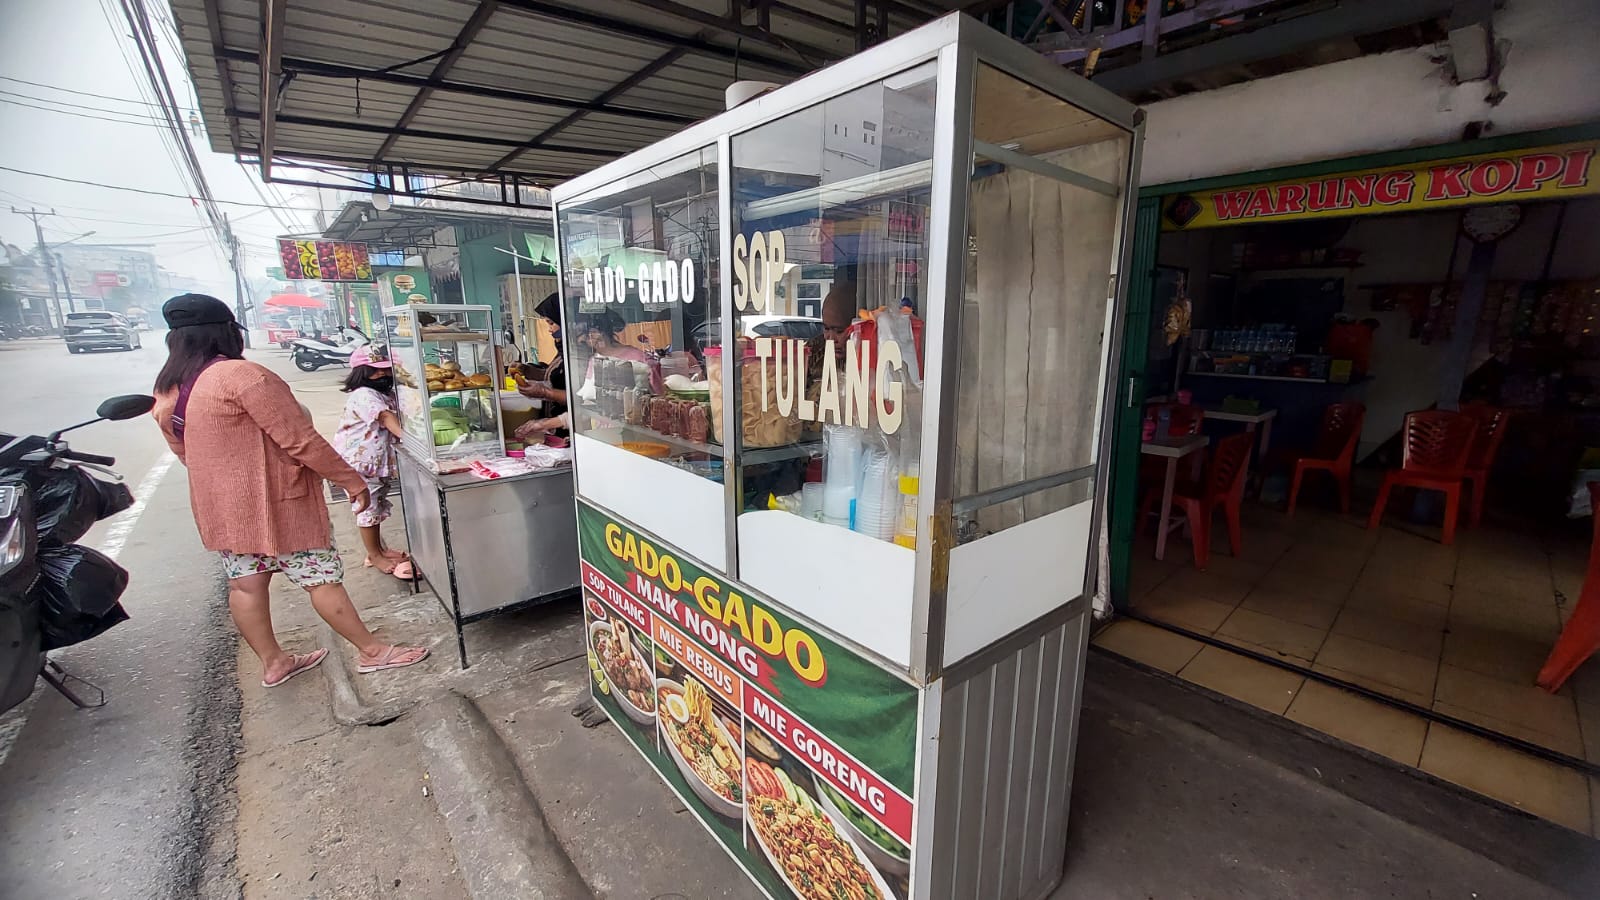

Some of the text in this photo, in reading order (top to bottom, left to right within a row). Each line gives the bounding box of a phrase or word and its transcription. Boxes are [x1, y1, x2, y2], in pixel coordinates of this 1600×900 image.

[1211, 149, 1594, 220] WARUNG KOPI
[733, 230, 786, 312] SOP
[755, 338, 903, 435] TULANG
[588, 571, 646, 626] SOP TULANG
[604, 522, 826, 684] GADO-GADO
[636, 574, 758, 678] MAK NONG
[658, 626, 733, 695] MIE REBUS
[753, 696, 886, 815] MIE GORENG
